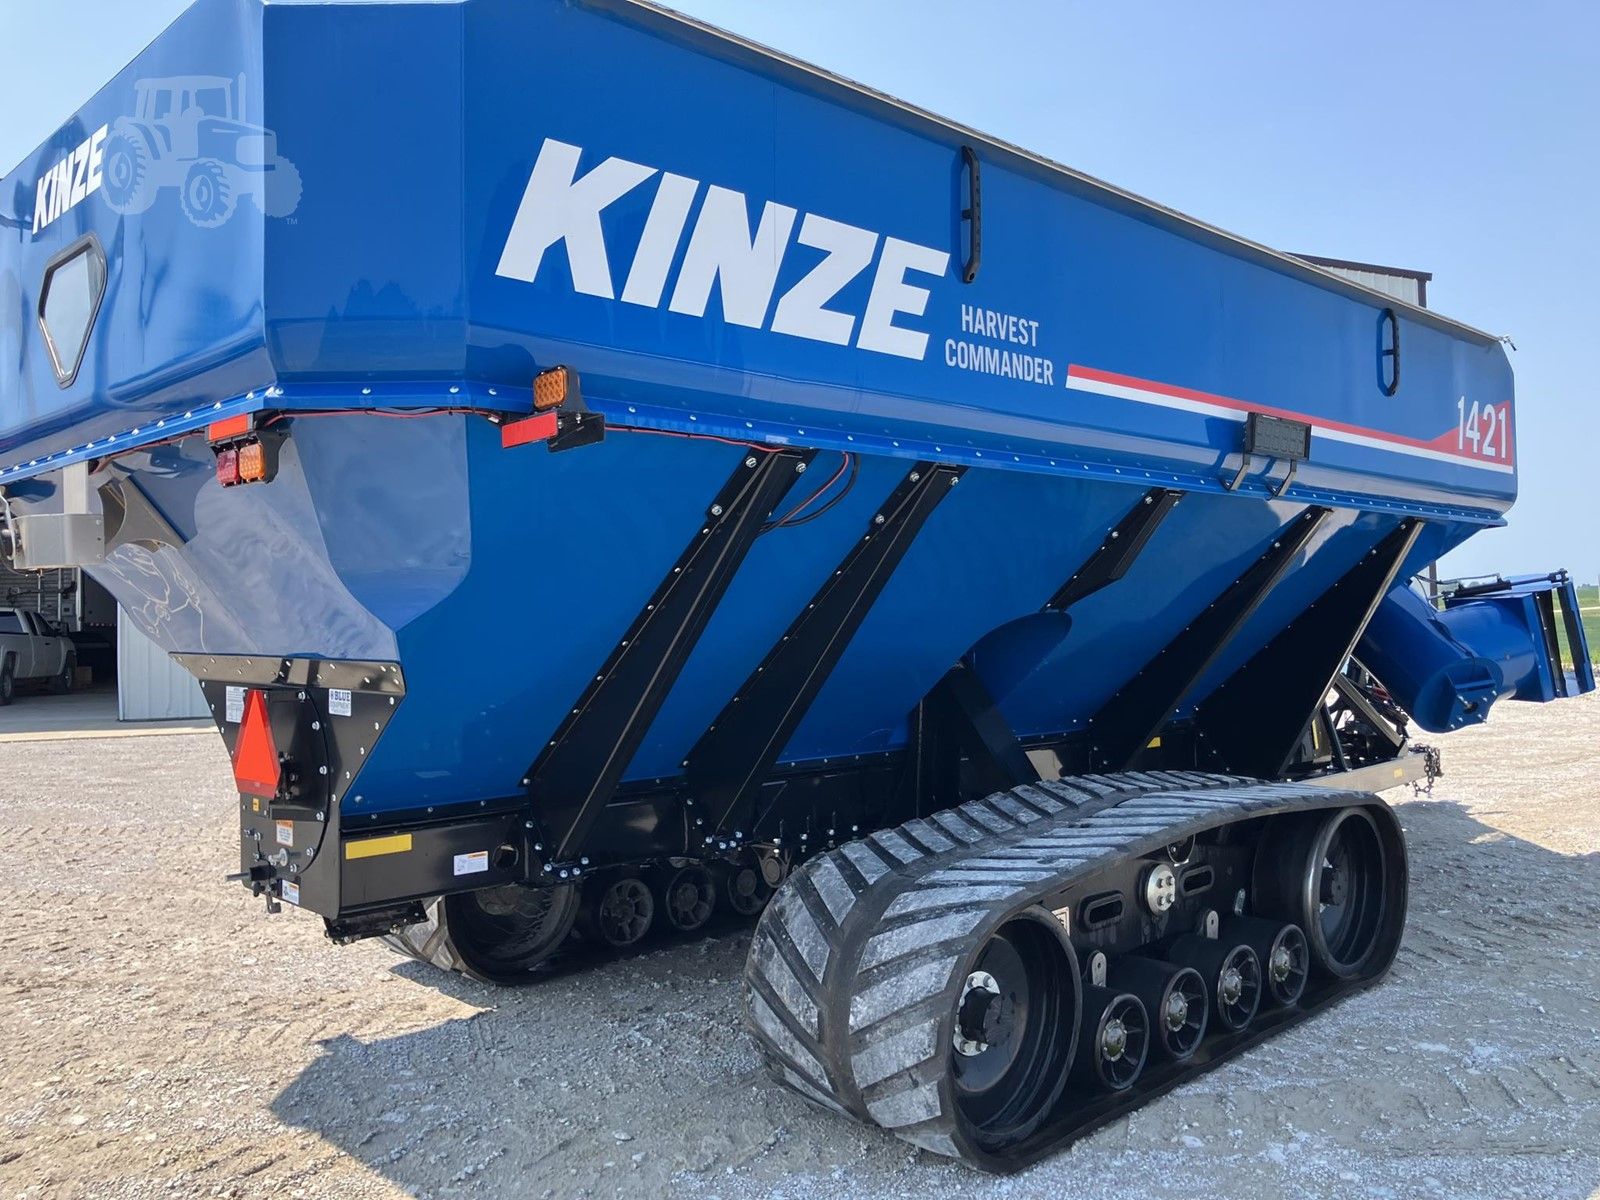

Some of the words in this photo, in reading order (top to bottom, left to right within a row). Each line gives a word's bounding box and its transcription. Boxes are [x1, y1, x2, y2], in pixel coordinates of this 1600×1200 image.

[32, 123, 108, 236] KINZE
[495, 137, 950, 361] KINZE
[961, 304, 1039, 347] HARVEST
[945, 338, 1054, 386] COMMANDER
[1457, 395, 1506, 459] 1421
[334, 690, 351, 702] BLUE
